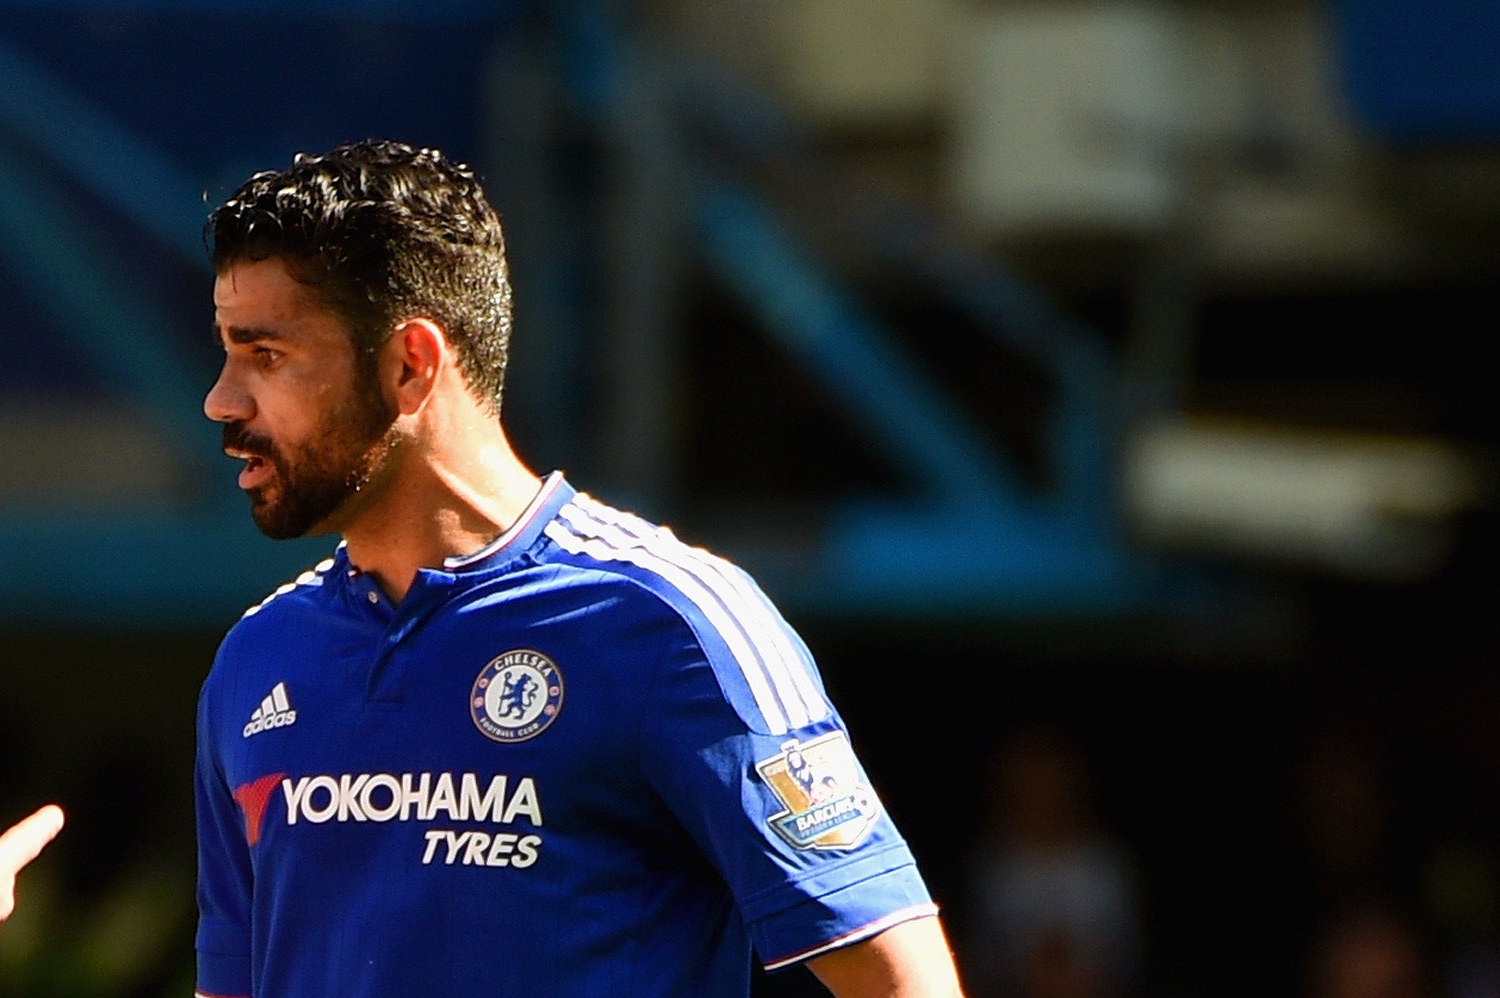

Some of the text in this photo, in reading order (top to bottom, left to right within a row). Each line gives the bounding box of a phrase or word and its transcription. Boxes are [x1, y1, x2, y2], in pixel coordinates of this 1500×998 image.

[494, 653, 554, 677] CHELSEA
[243, 710, 297, 739] adidas
[282, 772, 543, 827] YOKOHAMA
[422, 830, 543, 869] TYRES
